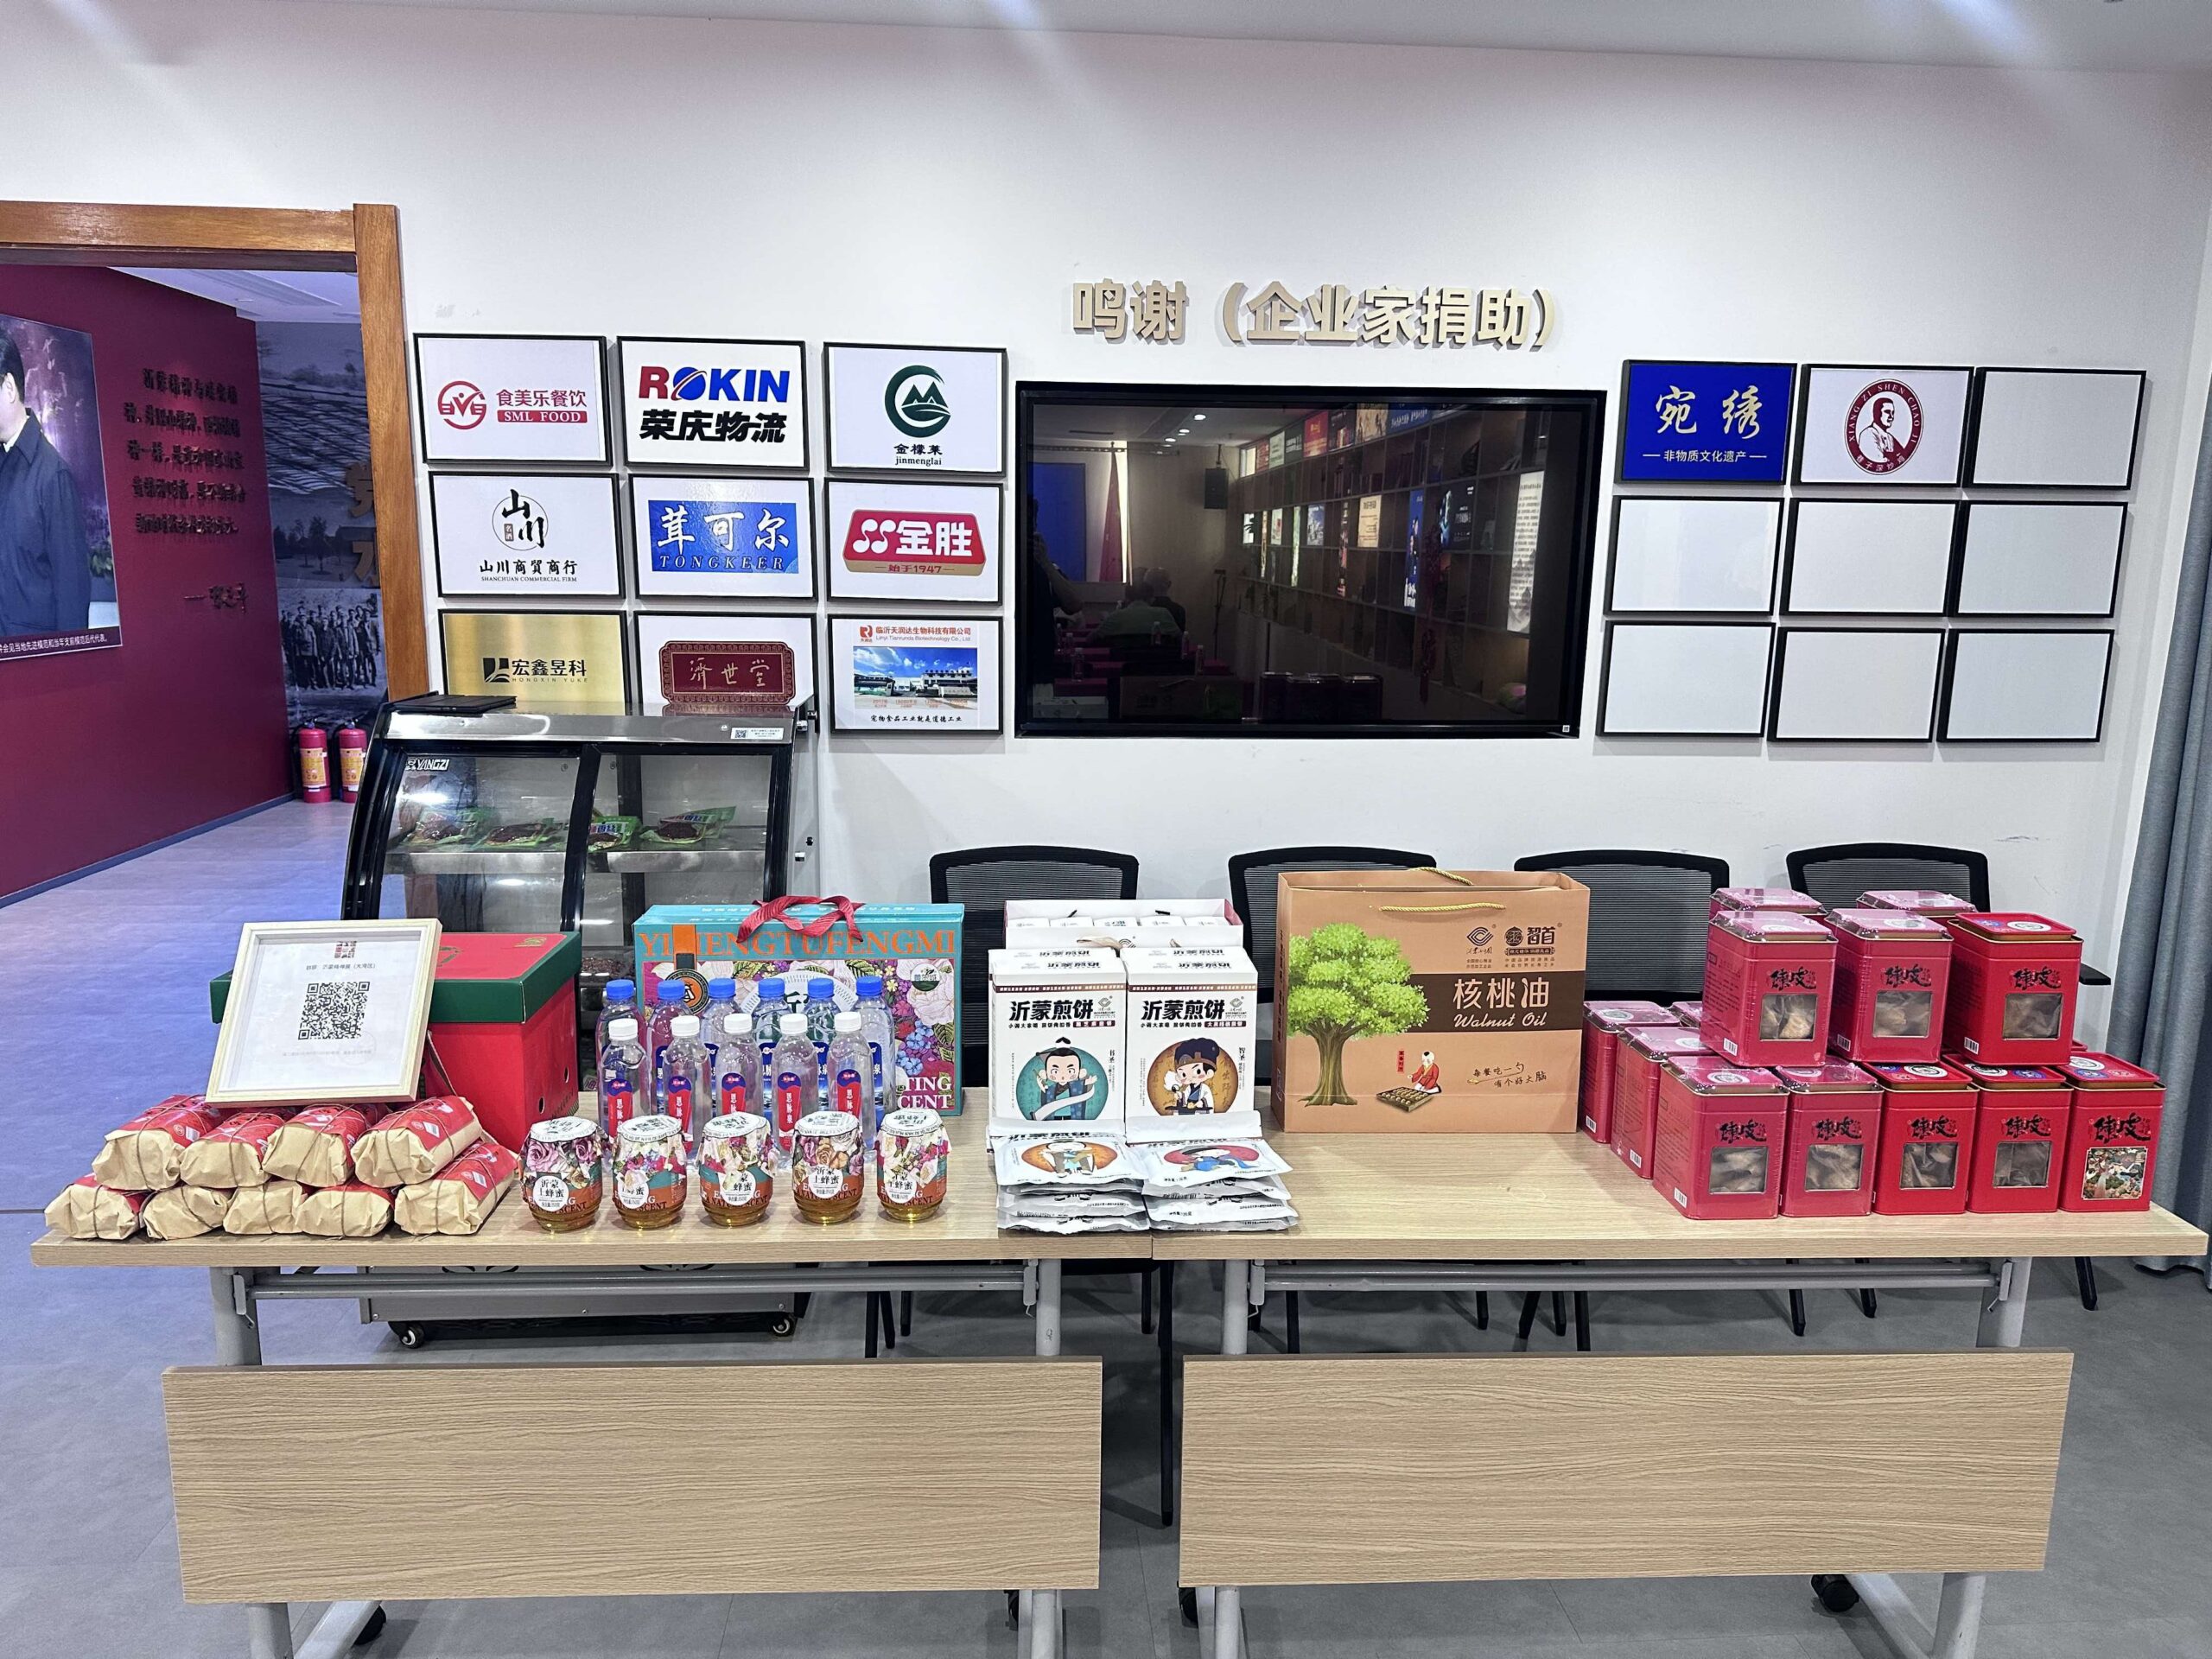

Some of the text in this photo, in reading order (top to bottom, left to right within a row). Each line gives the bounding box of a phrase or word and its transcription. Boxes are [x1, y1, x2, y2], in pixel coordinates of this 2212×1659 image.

[639, 365, 790, 403] ROKIN
[496, 389, 588, 408] 食美乐餐饮
[504, 411, 581, 422] SML FOOD
[1848, 406, 1860, 442] XIANG
[1861, 390, 1872, 401] ZI
[1878, 384, 1905, 395] SHEN
[1907, 397, 1920, 427] CHAO
[639, 409, 788, 443] 荣庆物流
[893, 443, 943, 455] 金檬莱
[1663, 449, 1746, 462] 非物质文化遗产
[895, 455, 942, 467] jinmenglai
[895, 520, 973, 556] 金胜
[659, 556, 784, 570] TONGKEER
[888, 564, 942, 574] 始于1947
[875, 626, 971, 635] 临沂天润达生物科技有限公司
[512, 658, 587, 677] 宏鑫昱科
[416, 759, 450, 771] YANGZI
[637, 930, 956, 957] YIENGTUFENGMI
[1452, 976, 1549, 1010] 核桃油
[1009, 999, 1094, 1021] 沂蒙煎饼
[1141, 999, 1225, 1021] 沂蒙煎饼
[1453, 1012, 1548, 1028] Walnut Oil
